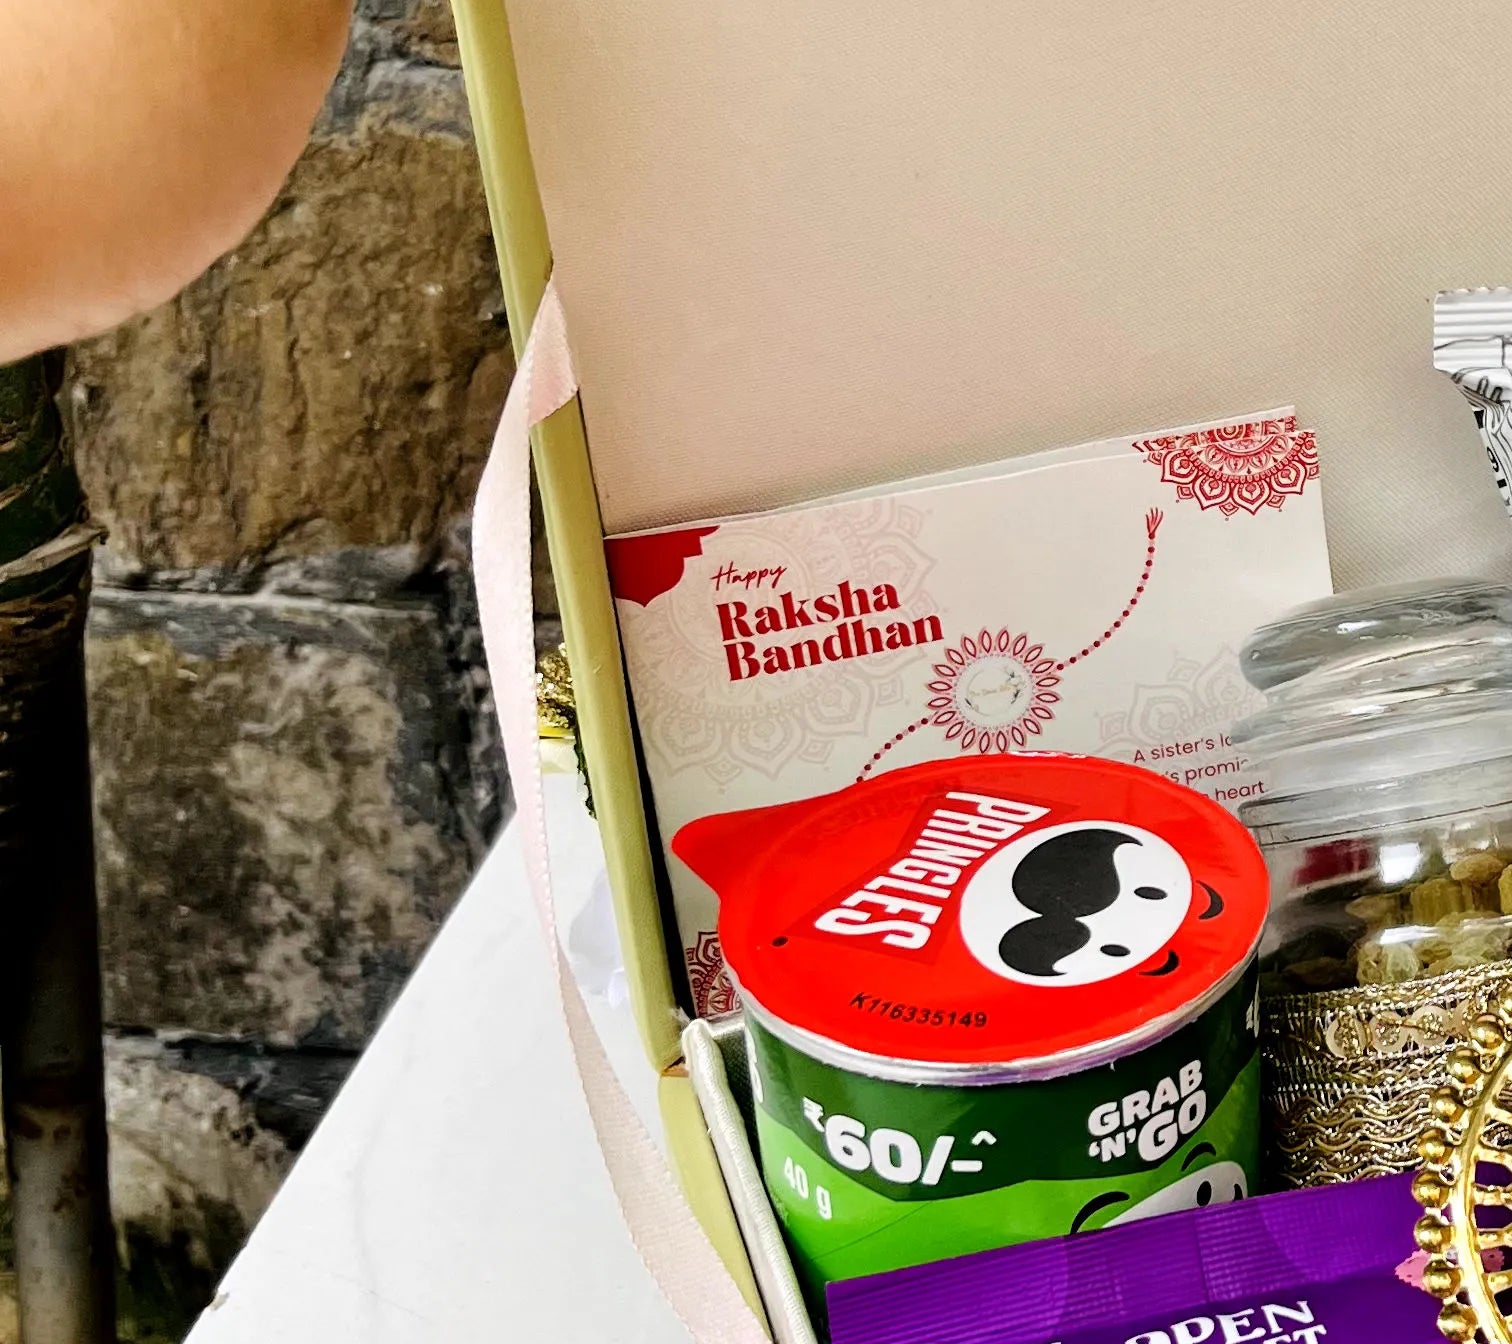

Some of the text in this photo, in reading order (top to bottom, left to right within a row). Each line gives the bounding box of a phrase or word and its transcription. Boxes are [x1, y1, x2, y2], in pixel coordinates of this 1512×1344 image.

[710, 561, 787, 591] Happy
[716, 580, 902, 641] Raksha
[723, 614, 945, 682] Bandhan
[1133, 749, 1146, 763] A
[1151, 737, 1216, 760] sister's
[1185, 756, 1250, 785] promi
[1215, 780, 1265, 802] heart
[812, 790, 1053, 951] PRINGLES
[850, 991, 988, 1028] K116335149
[1087, 1059, 1203, 1137] GRAB
[784, 1156, 833, 1221] 40 g
